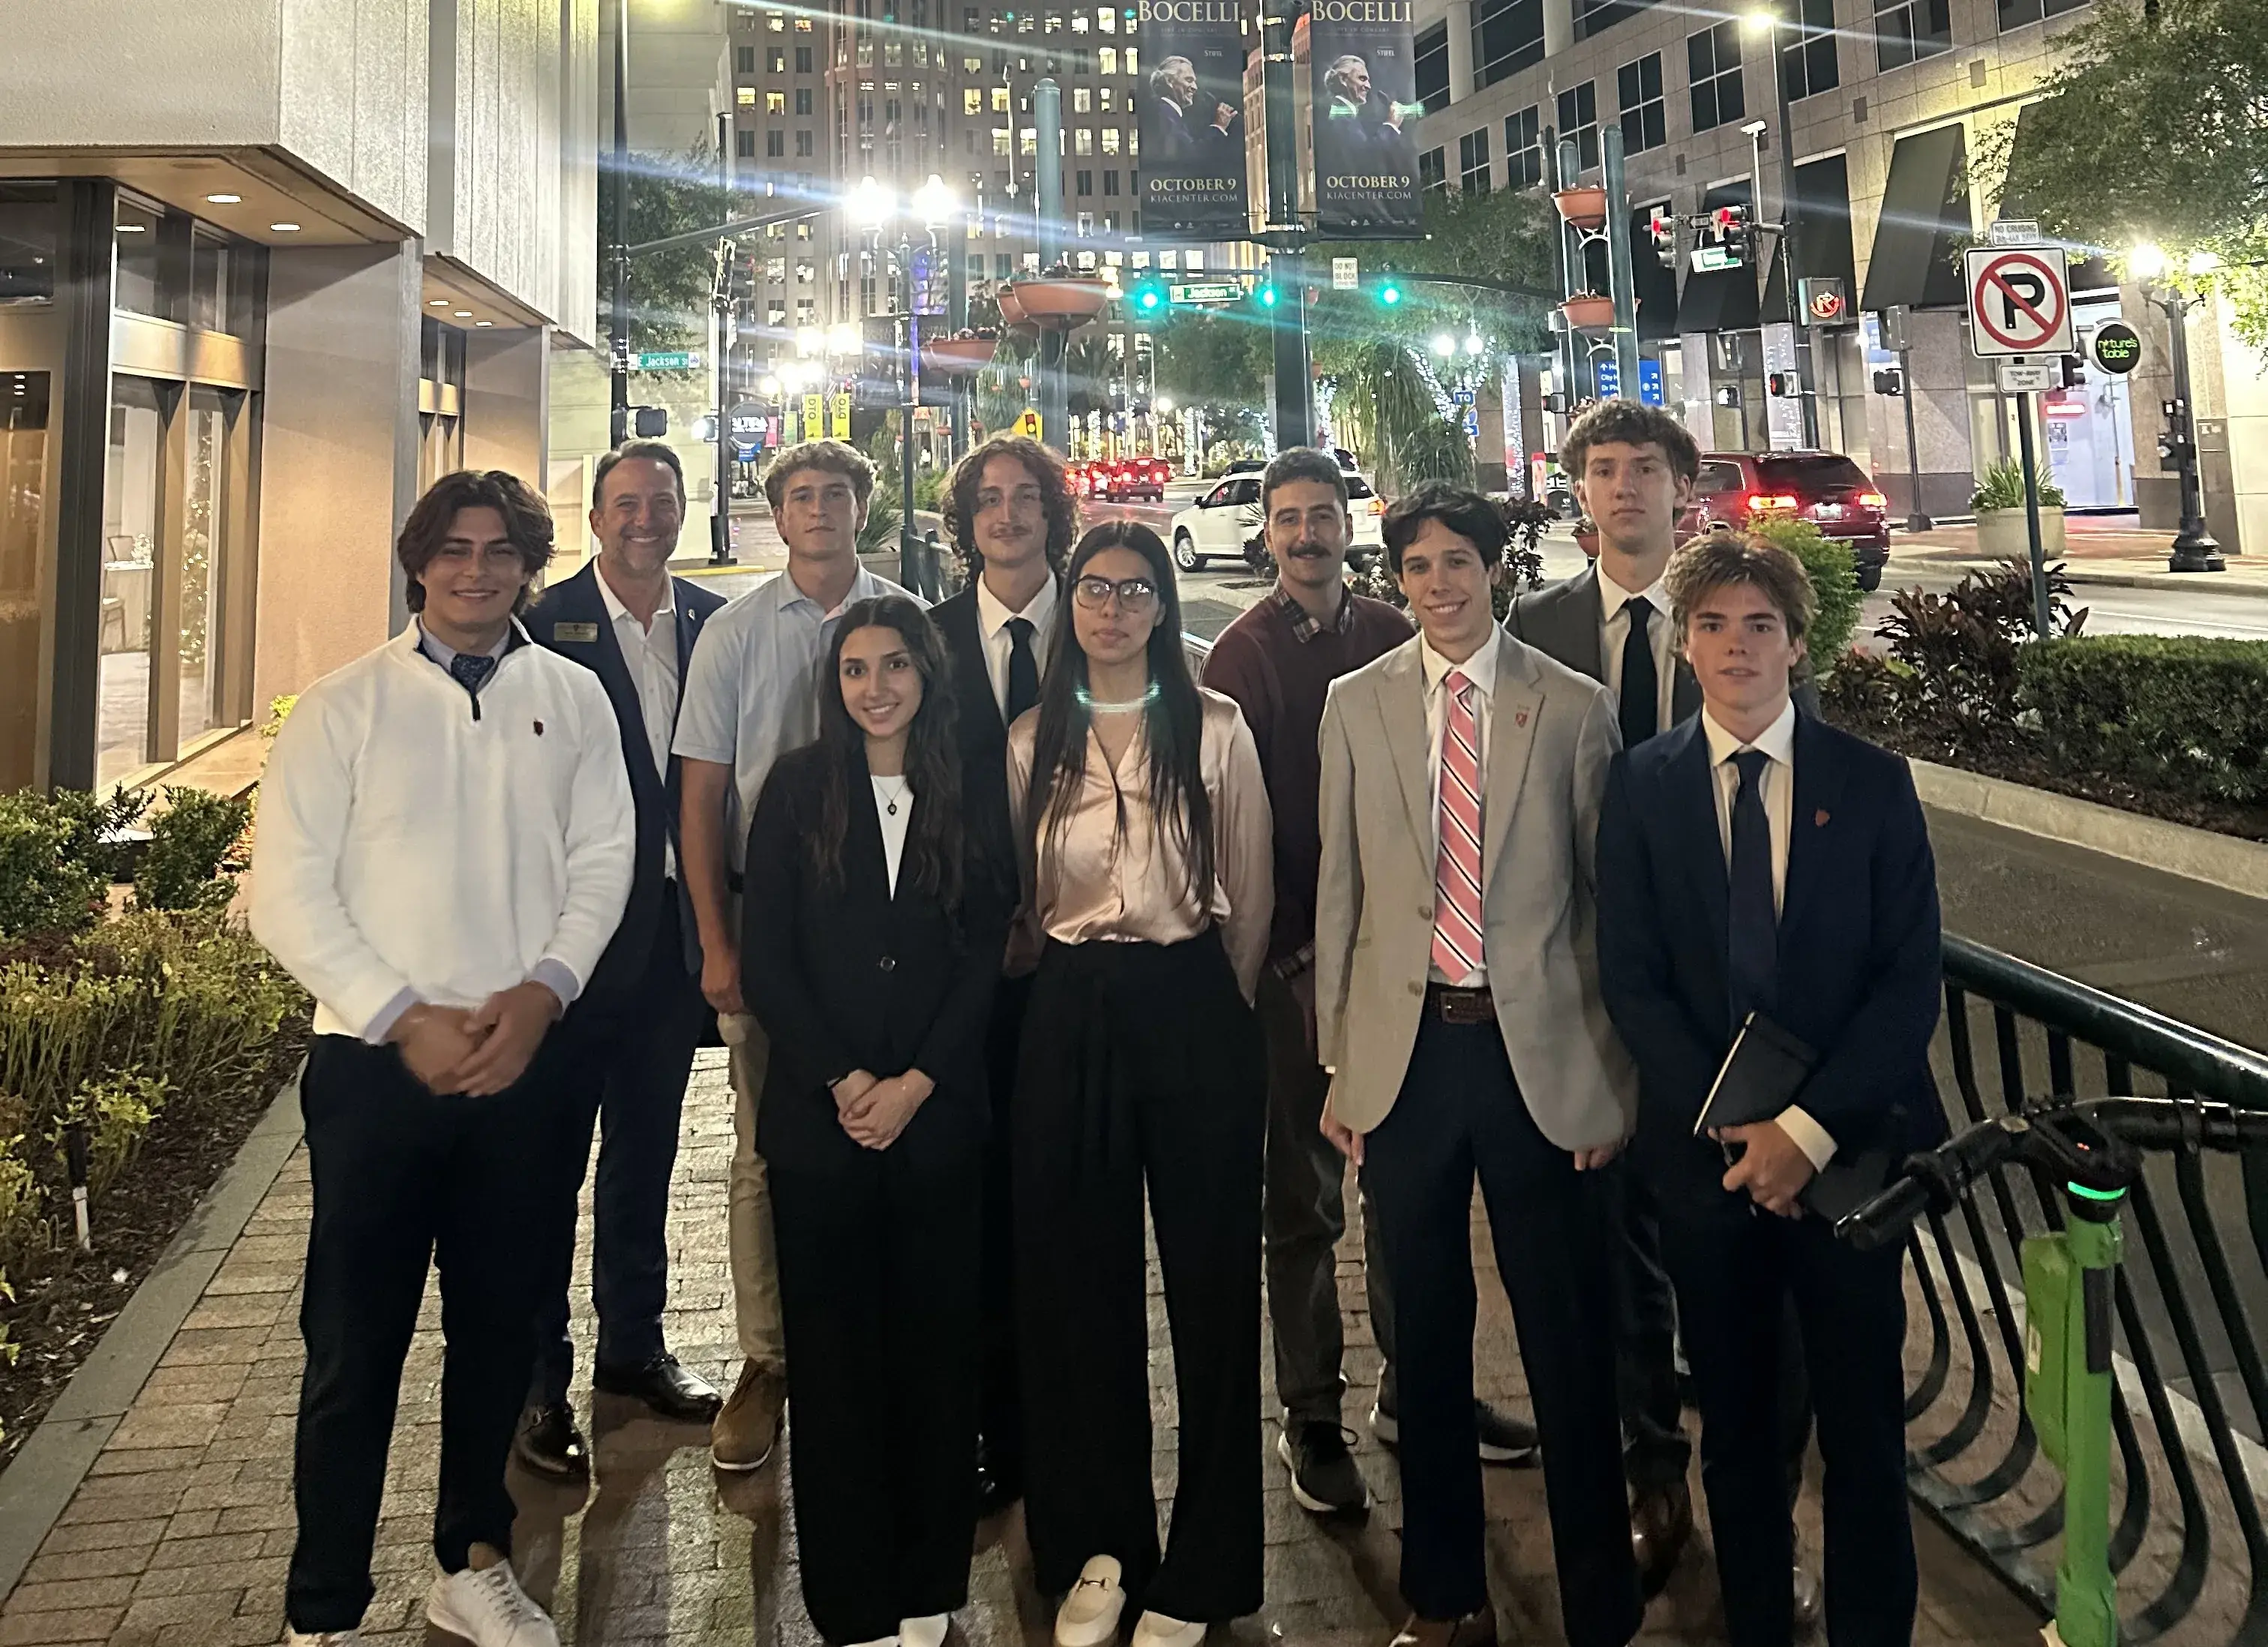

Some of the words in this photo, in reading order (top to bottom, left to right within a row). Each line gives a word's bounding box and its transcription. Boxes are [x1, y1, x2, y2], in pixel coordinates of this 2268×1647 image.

[1138, 0, 1240, 22] BOCELLI
[1312, 0, 1412, 22] BOCELLI
[1150, 178, 1226, 191] OCTOBER
[1228, 178, 1237, 190] 9
[1326, 176, 1399, 188] OCTOBER
[1401, 176, 1410, 188] 9
[638, 356, 644, 367] E
[646, 356, 680, 367] Jackson
[1457, 394, 1472, 402] TO
[838, 398, 847, 419] DTO
